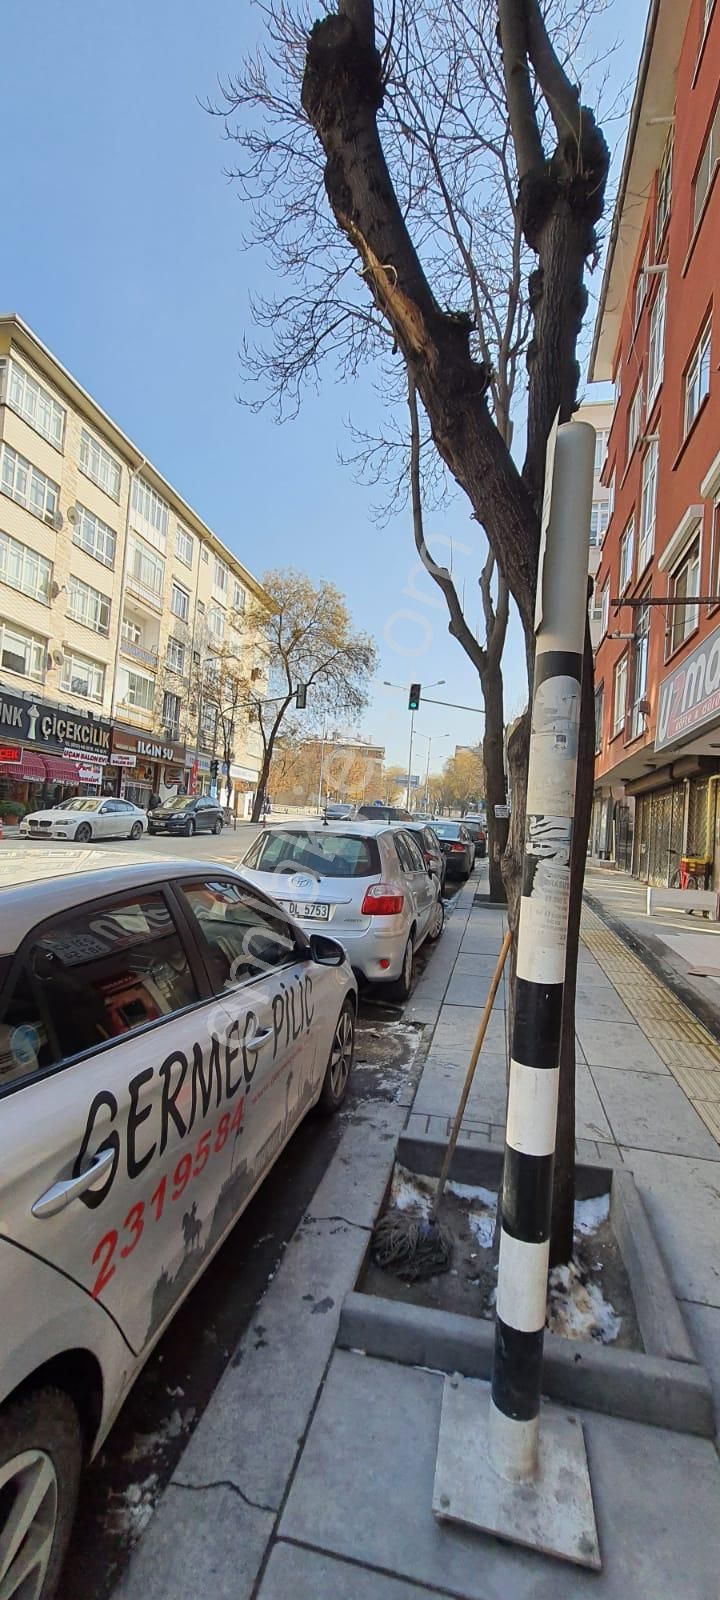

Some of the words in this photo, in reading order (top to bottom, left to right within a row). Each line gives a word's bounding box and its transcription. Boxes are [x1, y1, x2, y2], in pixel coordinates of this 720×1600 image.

[41, 714, 110, 749] ÇİÇEKCİLİK
[138, 740, 161, 757] ILGIN
[162, 748, 174, 761] SU
[289, 903, 299, 914] DL
[304, 904, 328, 917] 5753
[72, 1010, 259, 1209] GERMEÇ
[272, 975, 315, 1060] PİLİÇ
[90, 1096, 247, 1300] 2319584
